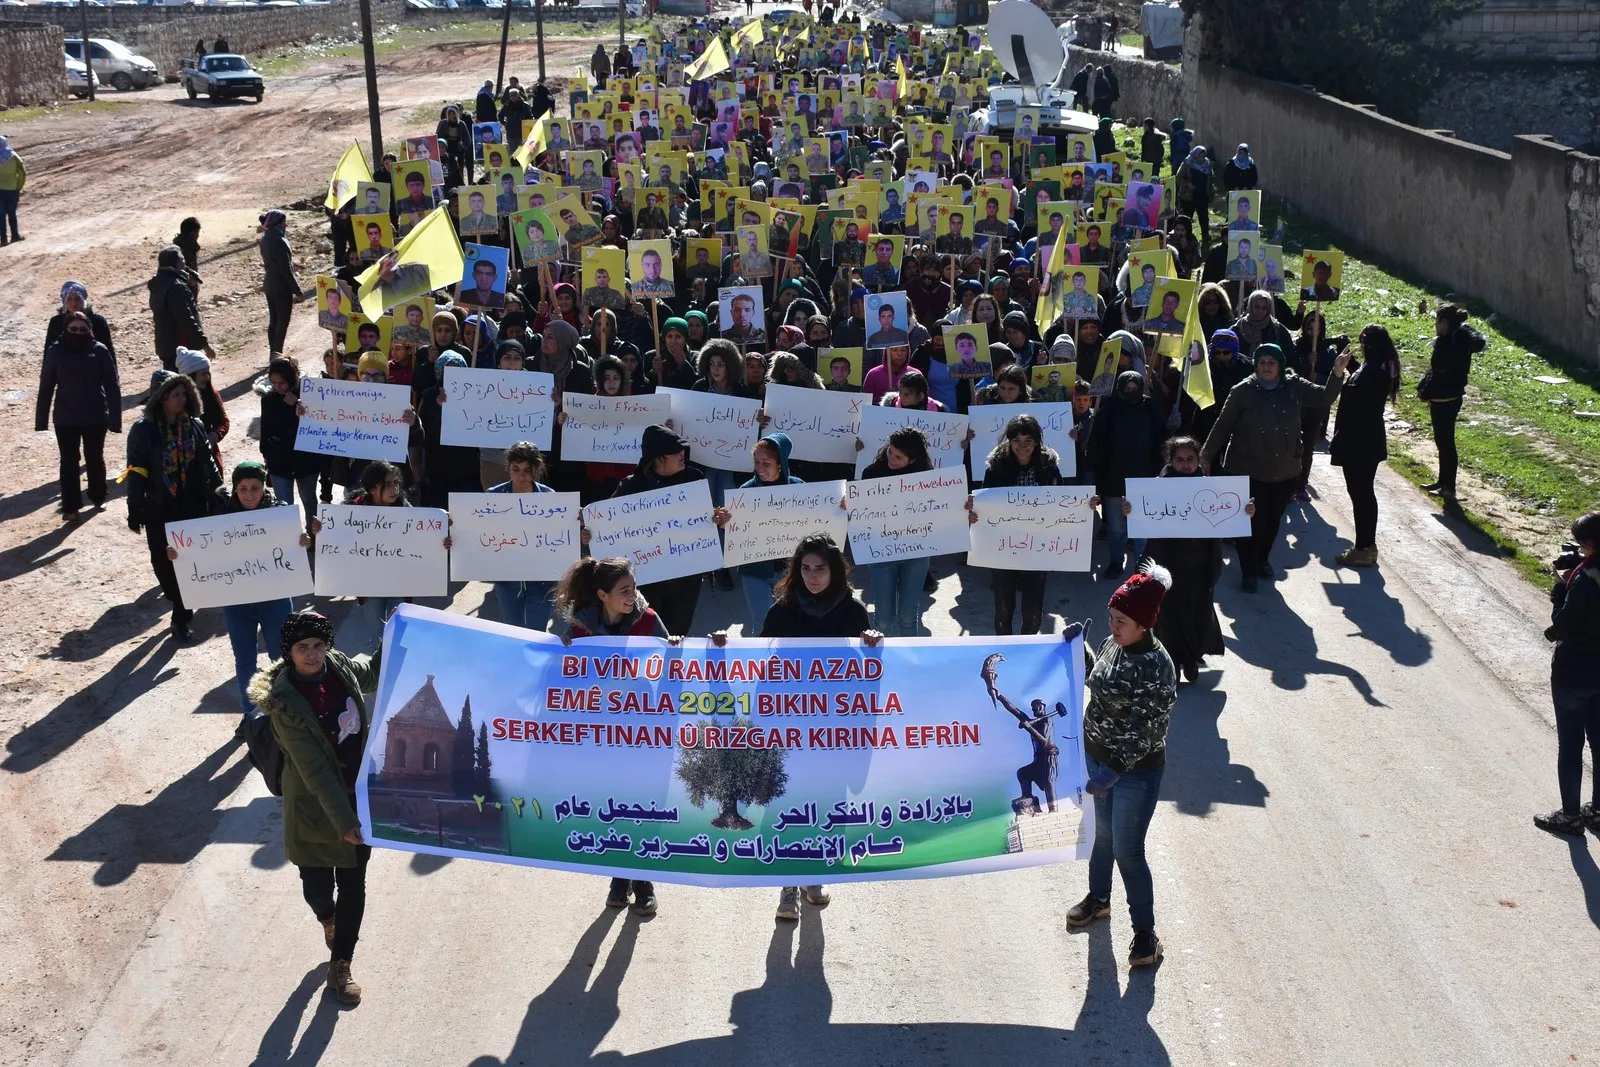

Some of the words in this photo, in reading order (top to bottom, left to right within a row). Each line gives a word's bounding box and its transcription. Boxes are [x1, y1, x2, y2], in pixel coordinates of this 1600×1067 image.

[302, 378, 314, 393] Bi
[451, 381, 473, 401] حرة
[497, 378, 547, 405] عفرين
[566, 397, 583, 408] Her
[847, 398, 863, 414] لا
[517, 409, 547, 433] تركيا
[729, 492, 746, 511] Na
[751, 497, 761, 512] ji
[848, 484, 860, 499] Bi
[518, 497, 568, 519] بعودتنا
[587, 506, 604, 521] Na
[607, 507, 617, 522] ji
[678, 490, 688, 502] û
[891, 504, 899, 517] û
[1142, 495, 1177, 521] قلوبنا
[1179, 502, 1192, 521] في
[1200, 499, 1232, 516] عفرين
[687, 512, 709, 526] emê
[728, 522, 740, 533] Na
[171, 529, 193, 549] Na
[321, 543, 341, 555] me
[535, 529, 571, 553] الحياة
[562, 655, 588, 678] BI
[593, 654, 639, 679] VÎN
[645, 654, 663, 680] Û
[668, 655, 801, 682] RAMANÊN
[808, 657, 883, 682] AZAD
[546, 685, 602, 712] EMÊ
[607, 690, 675, 714] SALA
[678, 691, 751, 715] 2021
[757, 692, 829, 716] BIKIN
[835, 691, 904, 715] SALA
[491, 717, 673, 748] SERKEFTINAN
[680, 722, 698, 749] Û
[705, 725, 802, 750] RIZGAR
[808, 725, 899, 749] KIRINA
[904, 720, 981, 748] EFRÎN
[553, 793, 592, 823] عام
[597, 796, 680, 825] سنجعل
[772, 800, 818, 832] الحر
[566, 827, 633, 854] عفرين
[850, 832, 905, 867] عام
